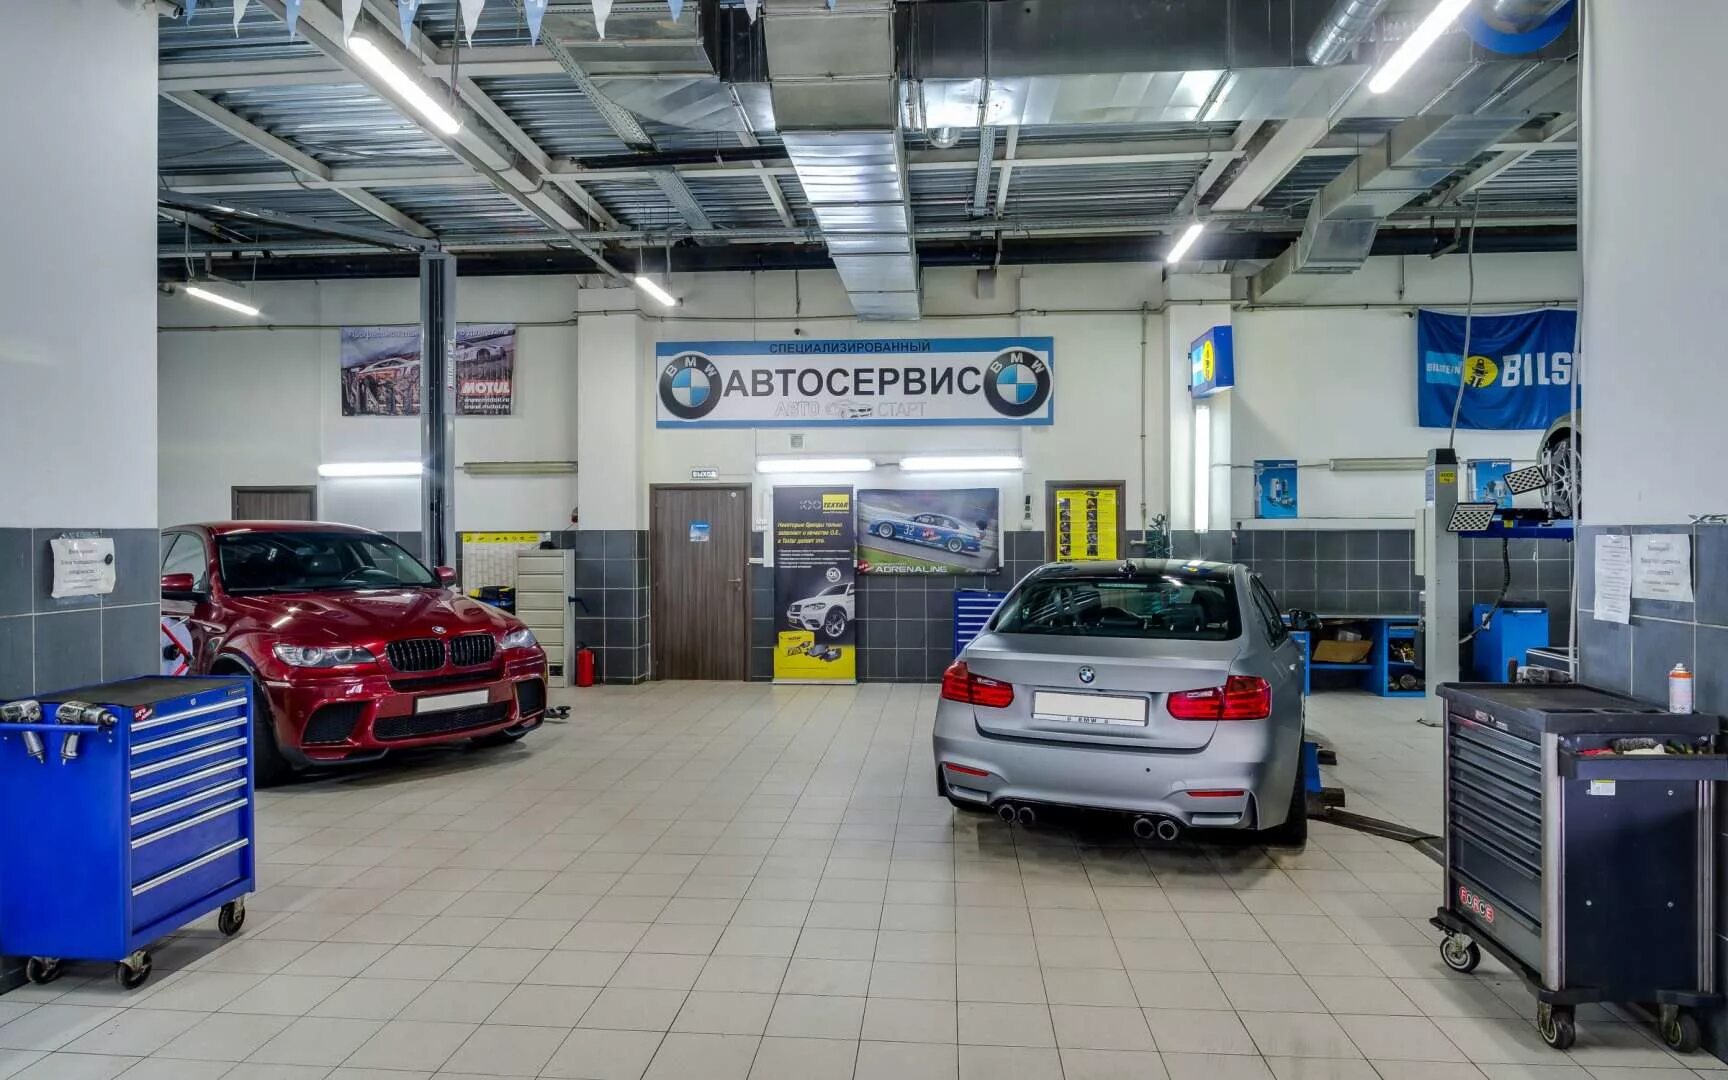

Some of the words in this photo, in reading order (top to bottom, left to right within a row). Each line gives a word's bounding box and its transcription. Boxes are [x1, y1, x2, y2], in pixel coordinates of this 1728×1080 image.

[770, 341, 931, 354] СПЕЦИАЛИЗИРОВАННЫЙ
[462, 382, 510, 394] MOTUL
[723, 367, 981, 397] АВТОСЕРВИС
[776, 401, 820, 416] АВТО
[878, 402, 928, 417] СТАРТ
[903, 524, 915, 536] 32
[1459, 886, 1495, 923] FORCE
